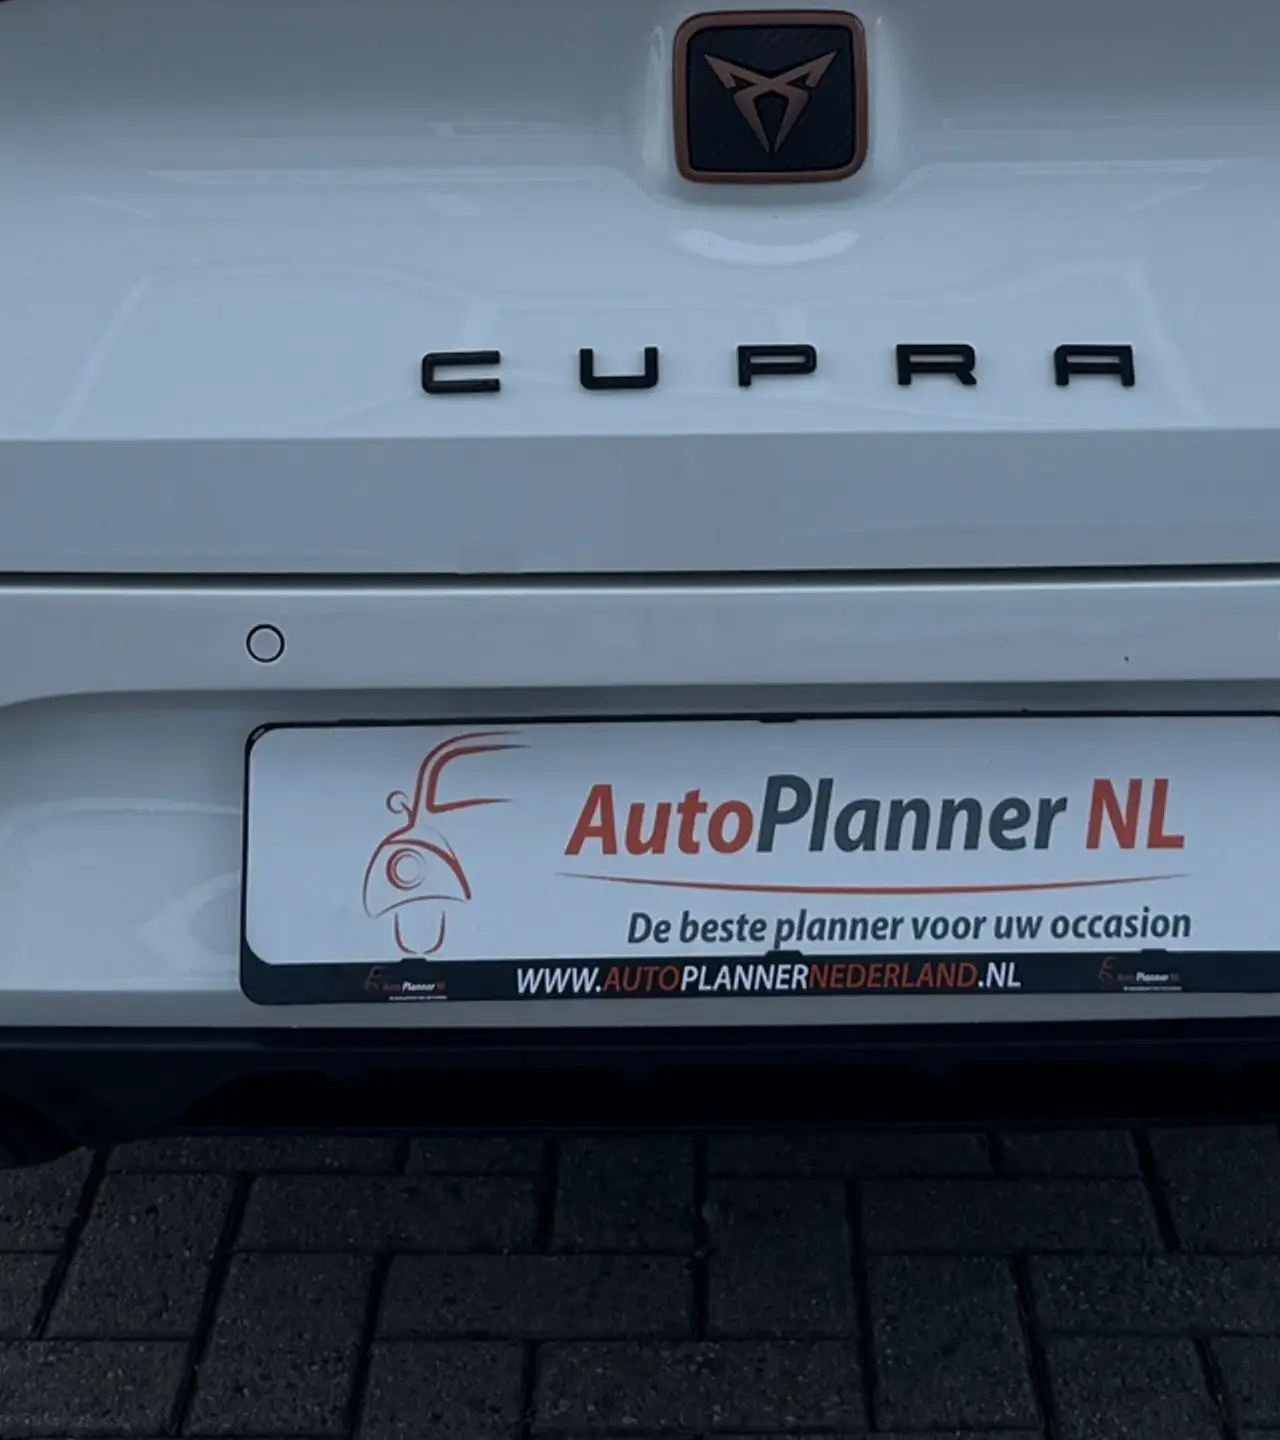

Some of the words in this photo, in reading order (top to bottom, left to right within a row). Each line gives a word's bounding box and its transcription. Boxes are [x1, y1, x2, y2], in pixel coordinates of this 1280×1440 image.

[420, 343, 1136, 395] CUPRA
[563, 773, 1068, 856] AutoPlanner
[1085, 777, 1186, 850] NL
[627, 911, 671, 945] De
[678, 908, 768, 944] beste
[773, 907, 902, 951] planner
[910, 912, 987, 942] voor
[993, 914, 1042, 940] uw
[1048, 907, 1192, 940] occasion
[516, 960, 1022, 994] WWW.AUTOPLANNERNEDERLAND.NL
